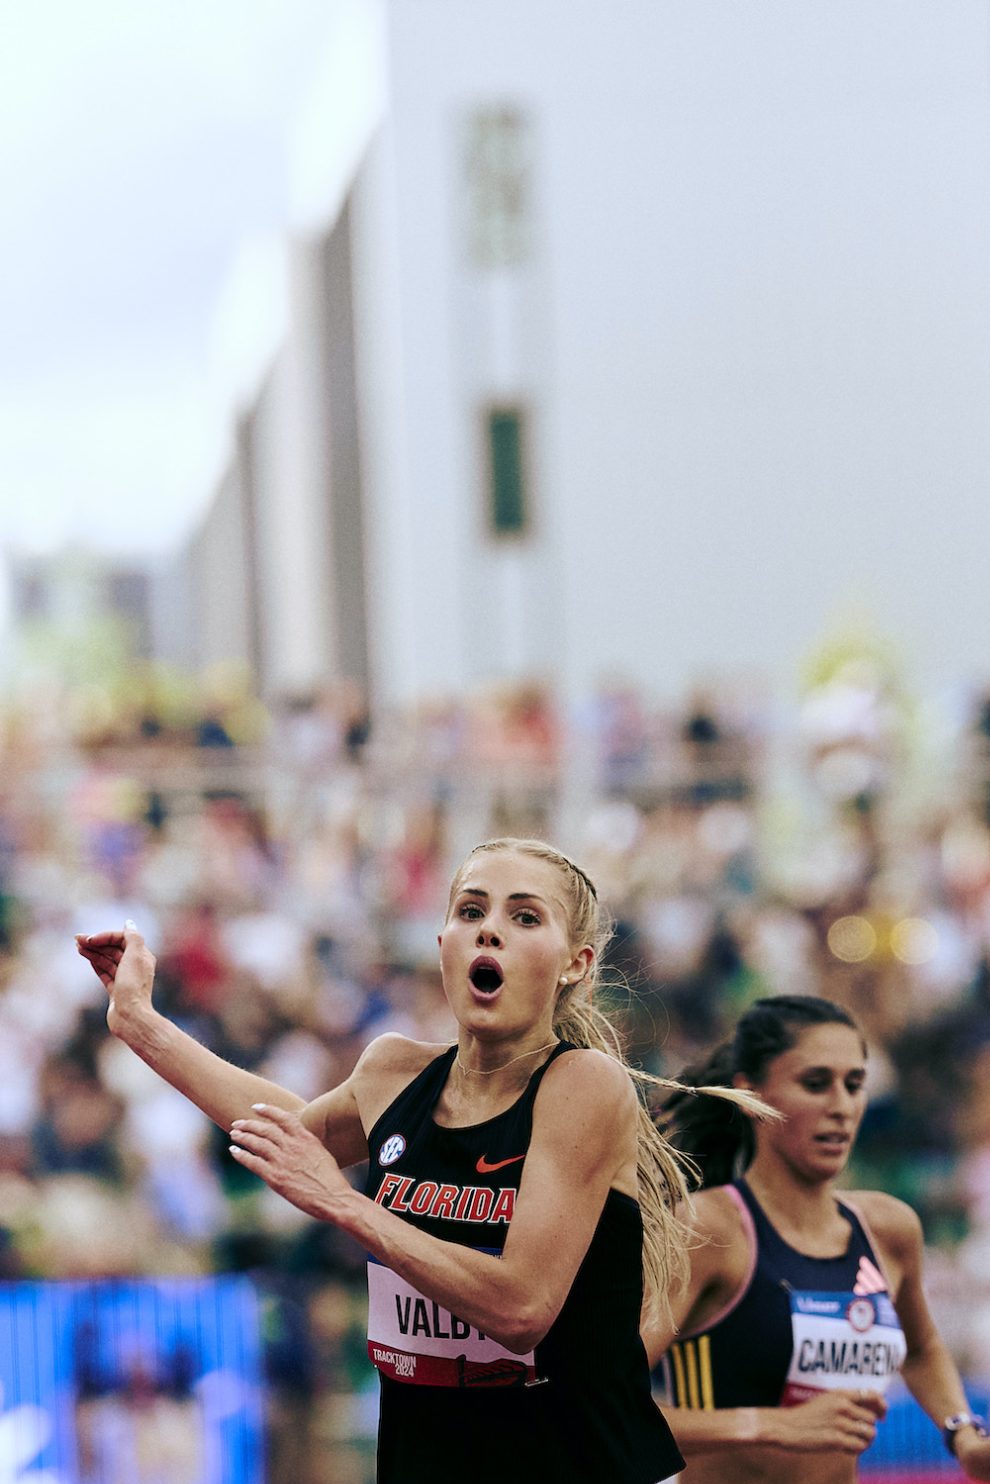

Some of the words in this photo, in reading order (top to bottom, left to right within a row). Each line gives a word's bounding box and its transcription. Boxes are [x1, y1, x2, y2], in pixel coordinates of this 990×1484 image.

[375, 1172, 517, 1223] FLORIDA
[373, 1348, 417, 1368] TRACKTOWN
[395, 1363, 415, 1377] 2024
